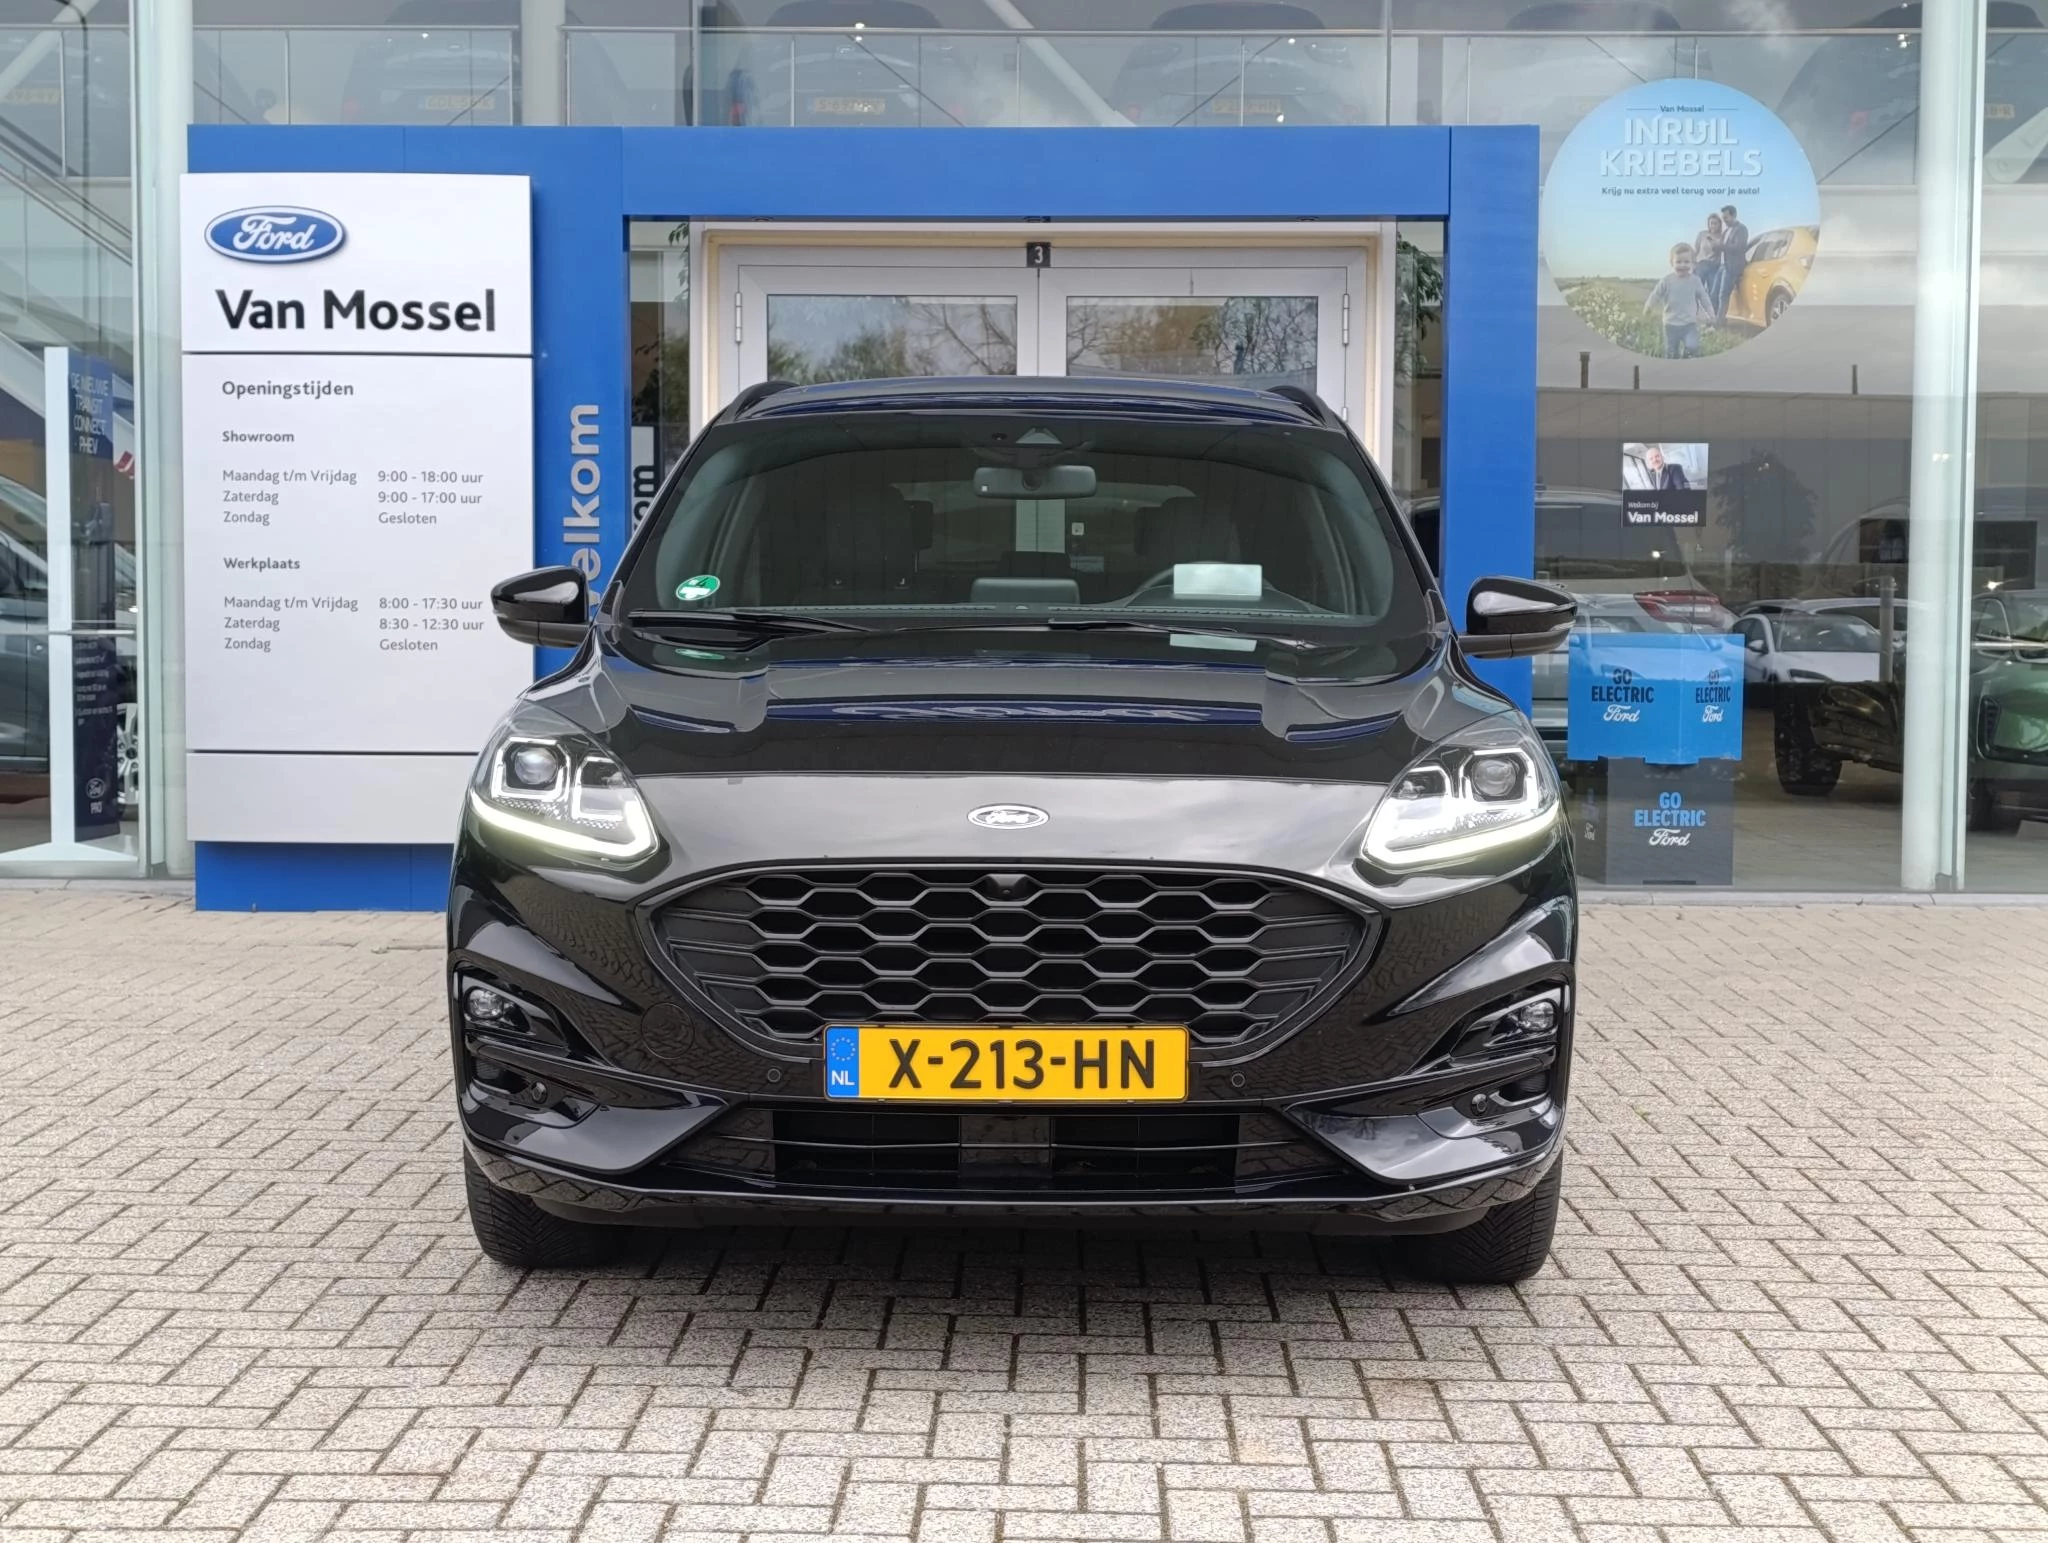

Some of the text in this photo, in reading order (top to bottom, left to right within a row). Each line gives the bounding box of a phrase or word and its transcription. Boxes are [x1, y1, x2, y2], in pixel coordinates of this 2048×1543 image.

[1660, 105, 1705, 113] Van Mossel
[1624, 115, 1740, 145] INRUIL
[1600, 149, 1763, 177] KRIEBELS
[1601, 187, 1622, 197] Krijg
[1636, 187, 1659, 195] extra
[1661, 187, 1680, 195] veel
[1681, 187, 1705, 197] terug
[1727, 187, 1736, 197] je
[1738, 187, 1760, 195] auto!
[232, 214, 318, 250] Ford
[1034, 245, 1044, 264] 3
[214, 288, 496, 332] Van Mossel
[221, 380, 354, 400] Openingstijden
[221, 430, 295, 443] Showroom
[222, 469, 280, 485] Maandag
[283, 469, 307, 484] t/m
[310, 470, 358, 486] Vrijdag
[377, 470, 408, 483] 9:00
[421, 471, 458, 484] 18:00
[461, 474, 484, 484] uur
[222, 490, 279, 506] Zaterdag
[377, 491, 408, 504] 9:00
[421, 492, 457, 504] 17:00
[460, 495, 483, 504] uur
[223, 511, 438, 527] Zondag Gesloten
[1628, 511, 1699, 524] Van Mossel
[223, 557, 301, 573] Werkplaats
[223, 596, 281, 612] Maandag
[284, 596, 308, 611] t/m
[311, 596, 359, 612] Vrijdag
[379, 597, 410, 610] 8:00
[422, 598, 458, 610] 17:30
[461, 600, 484, 610] uur
[223, 616, 281, 632] Zaterdag
[379, 618, 410, 631] 8:30
[422, 618, 459, 631] 12:30
[462, 622, 485, 631] uur
[223, 637, 439, 653] Zondag Gesloten
[1612, 668, 1633, 685] GO
[1708, 669, 1720, 685] GO
[1591, 686, 1655, 703] ELECTRIC
[1695, 686, 1731, 704] ELECTRIC
[1602, 703, 1641, 723] Ford
[1702, 704, 1724, 723] Ford
[1659, 791, 1682, 809] GO
[1634, 809, 1707, 827] ELECTRIC
[1648, 828, 1691, 847] Ford
[888, 1038, 1155, 1090] X-213-HN
[831, 1070, 855, 1086] NL
